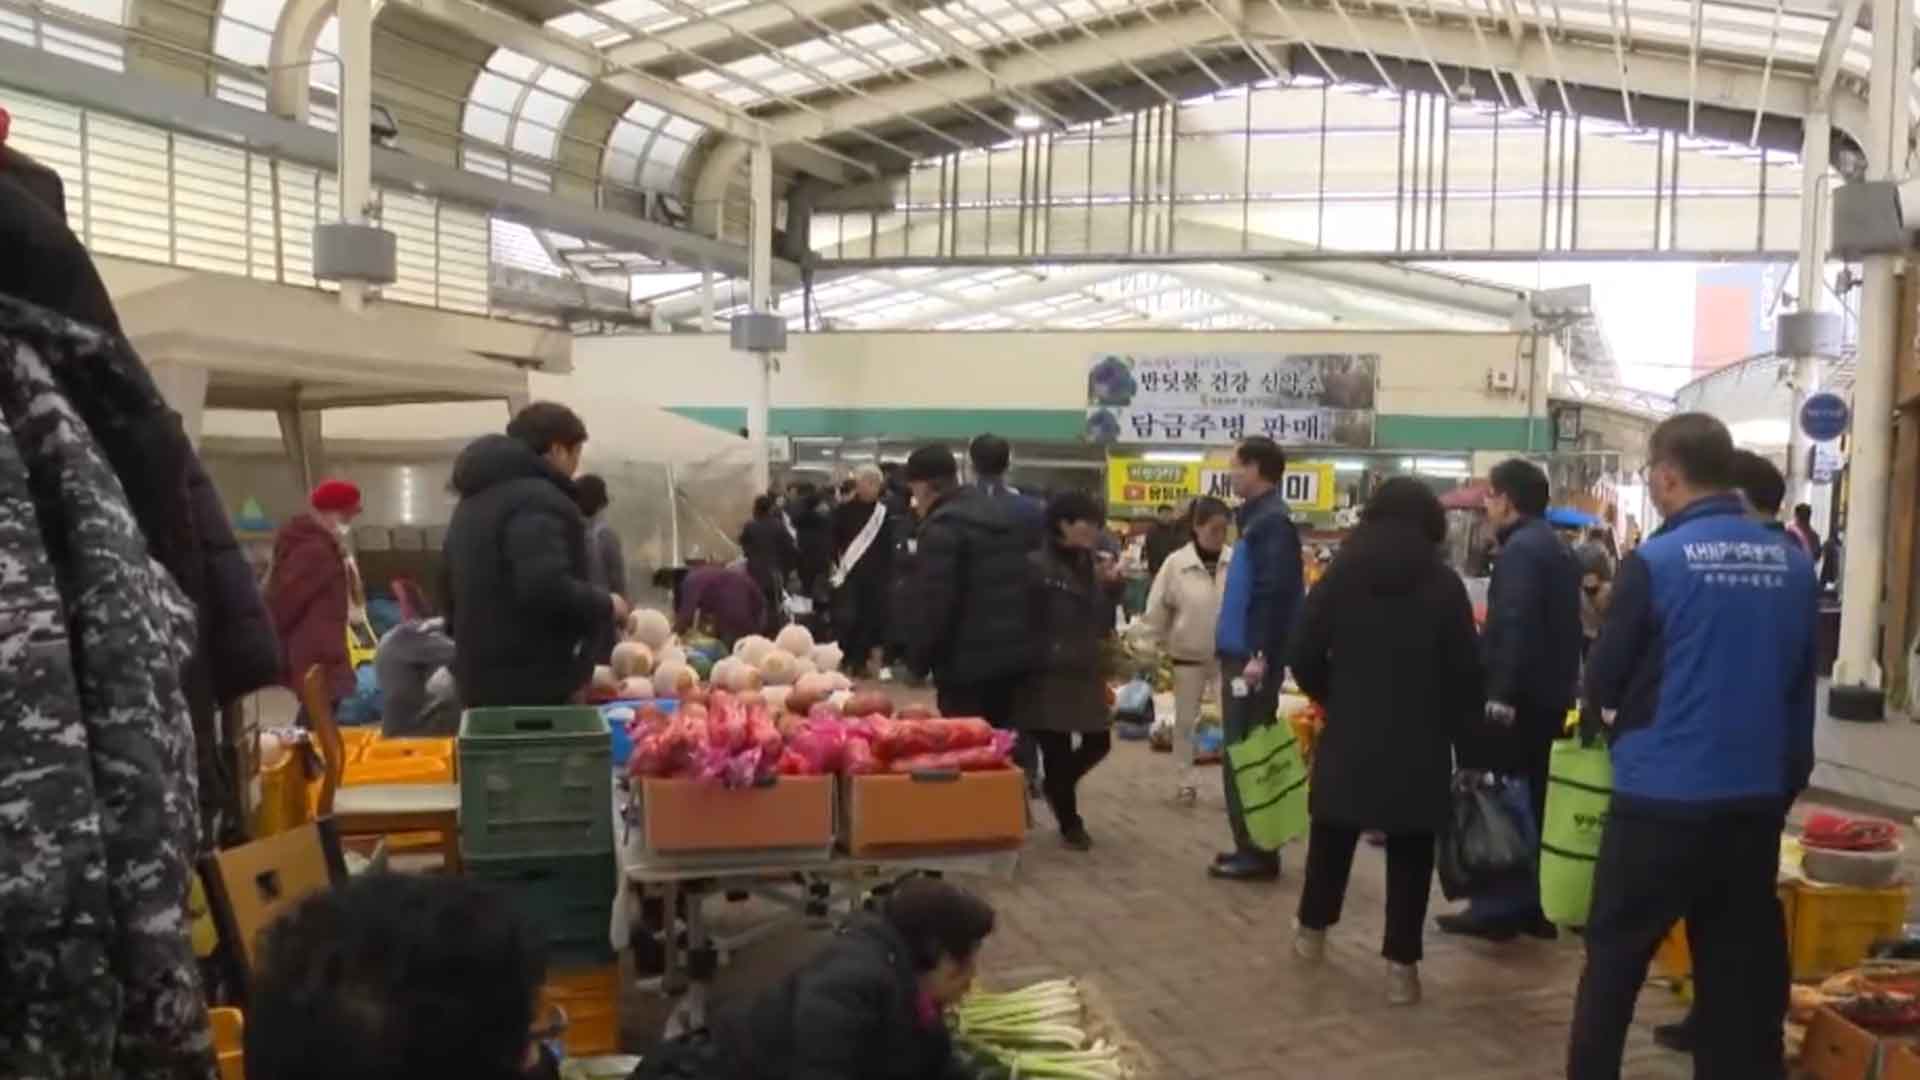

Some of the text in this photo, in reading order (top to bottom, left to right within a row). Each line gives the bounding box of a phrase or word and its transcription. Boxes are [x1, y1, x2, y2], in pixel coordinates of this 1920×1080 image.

[1141, 370, 1201, 393] 반딧불
[1211, 370, 1250, 394] 건강
[1131, 413, 1246, 440] 담금주병
[1262, 413, 1319, 440] 판매
